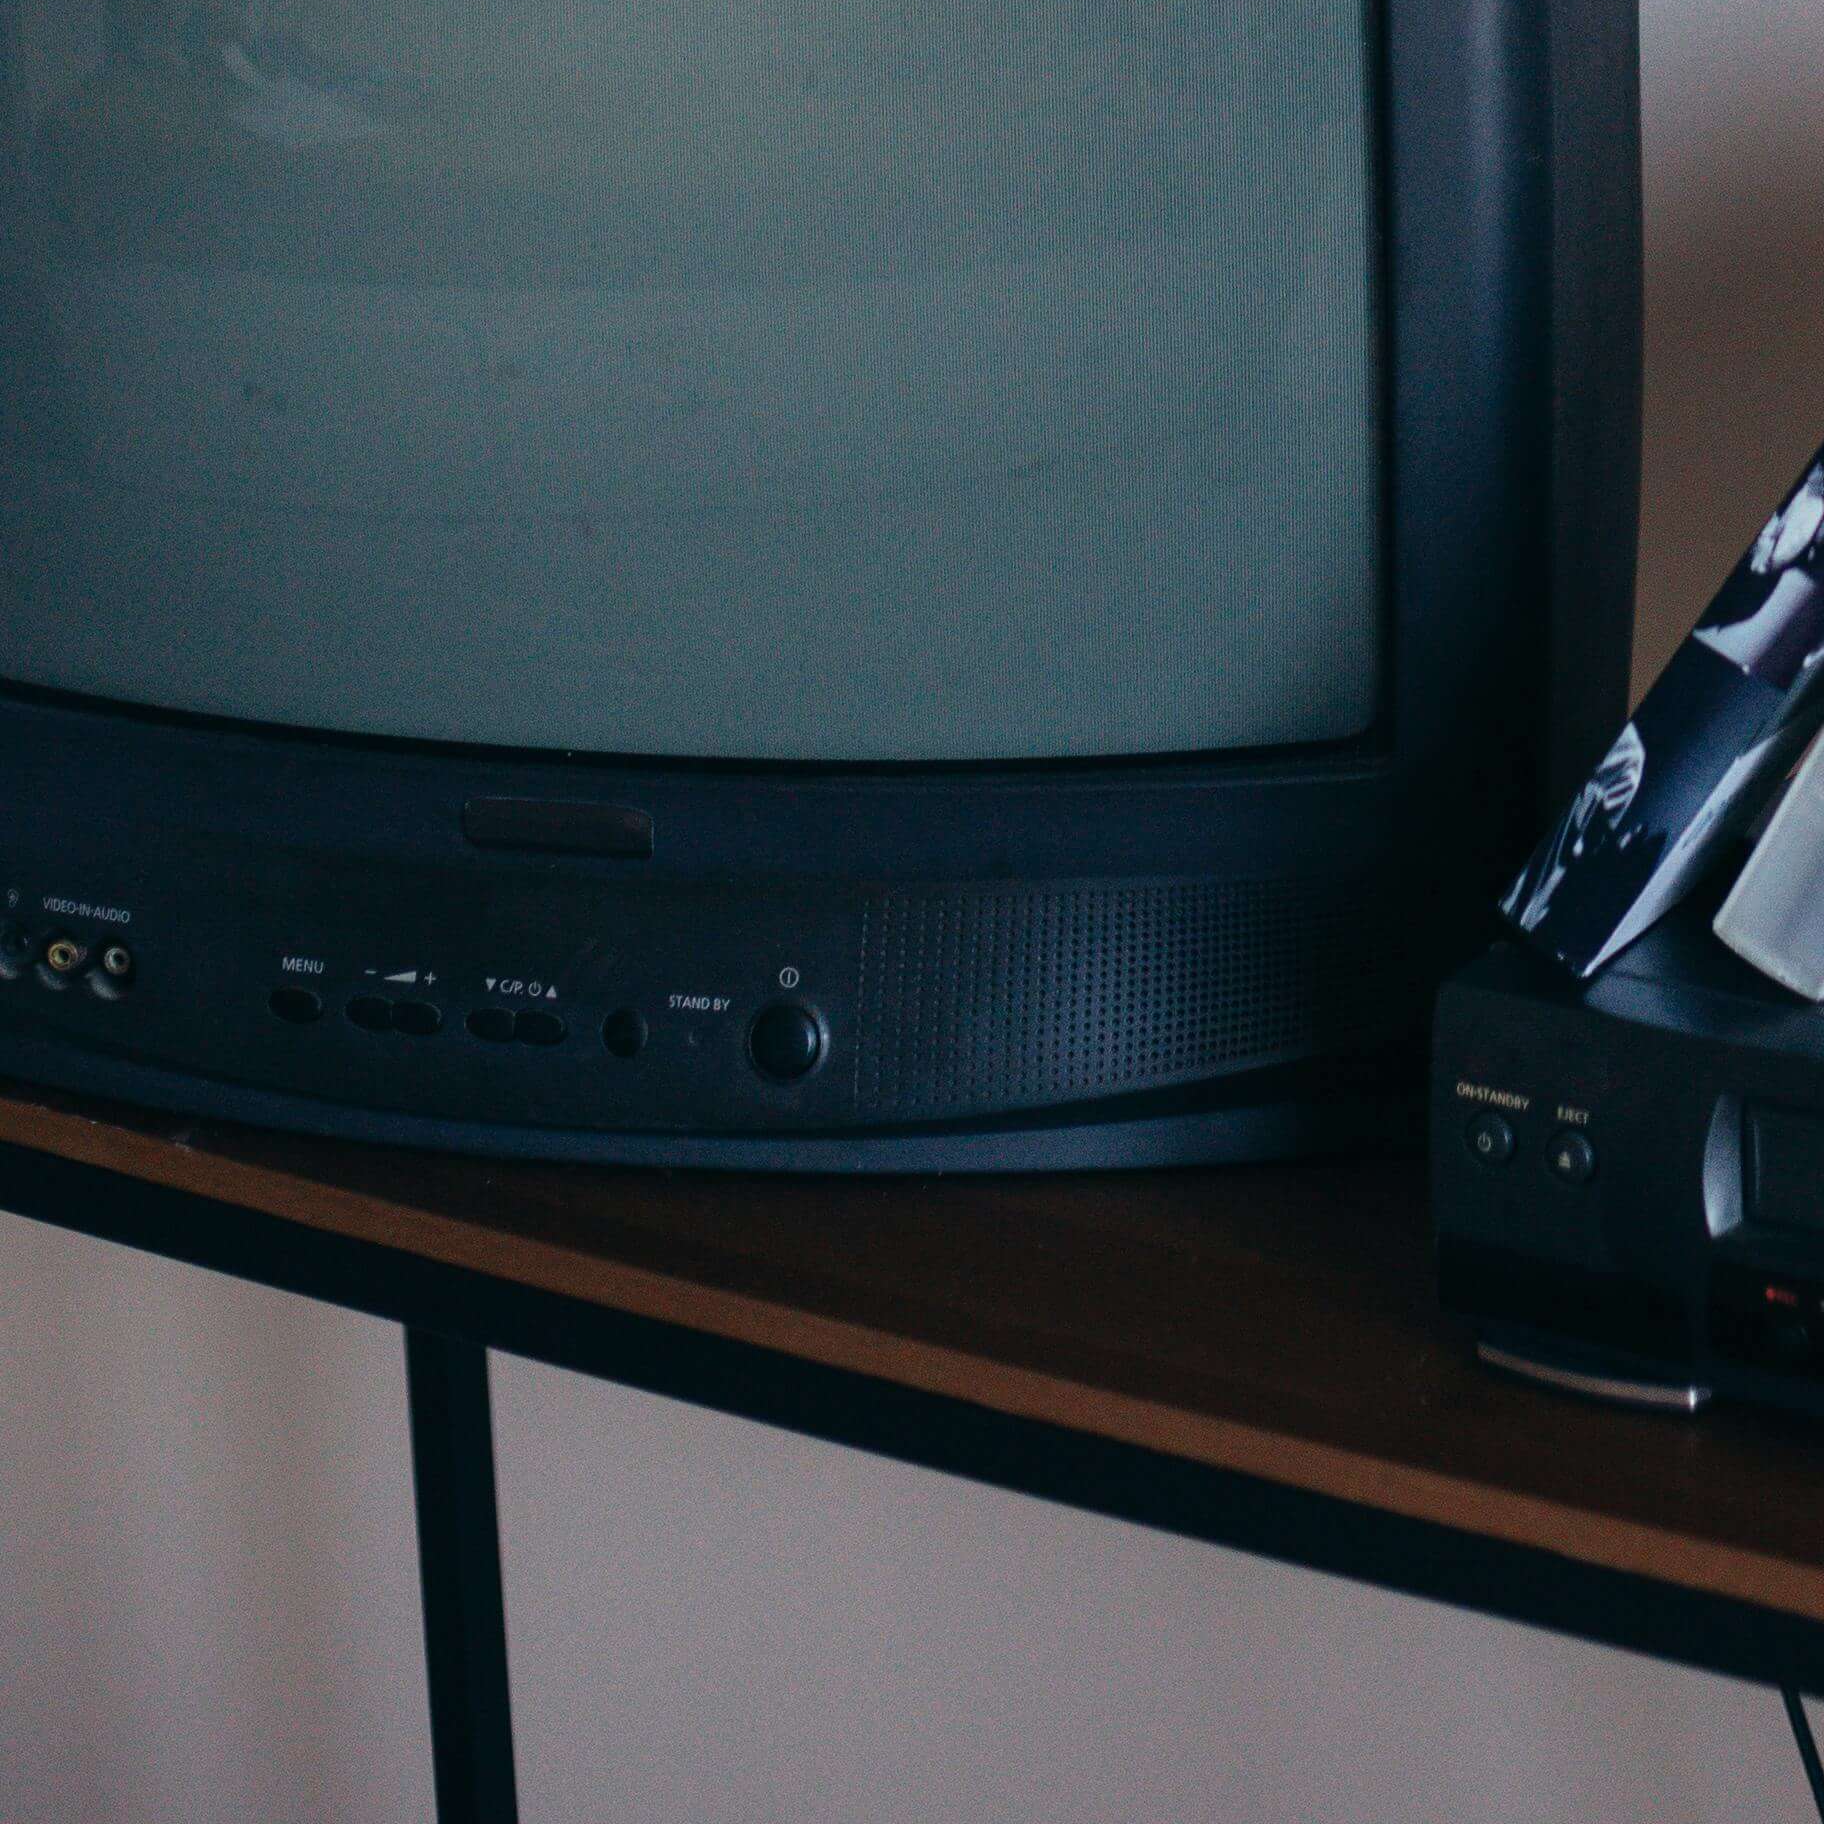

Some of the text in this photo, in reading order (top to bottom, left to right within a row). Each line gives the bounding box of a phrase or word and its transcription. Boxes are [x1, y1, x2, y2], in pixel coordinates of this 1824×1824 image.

[282, 956, 325, 975] MENU
[668, 994, 731, 1012] STAND BY
[1557, 1106, 1589, 1126] EJECT
